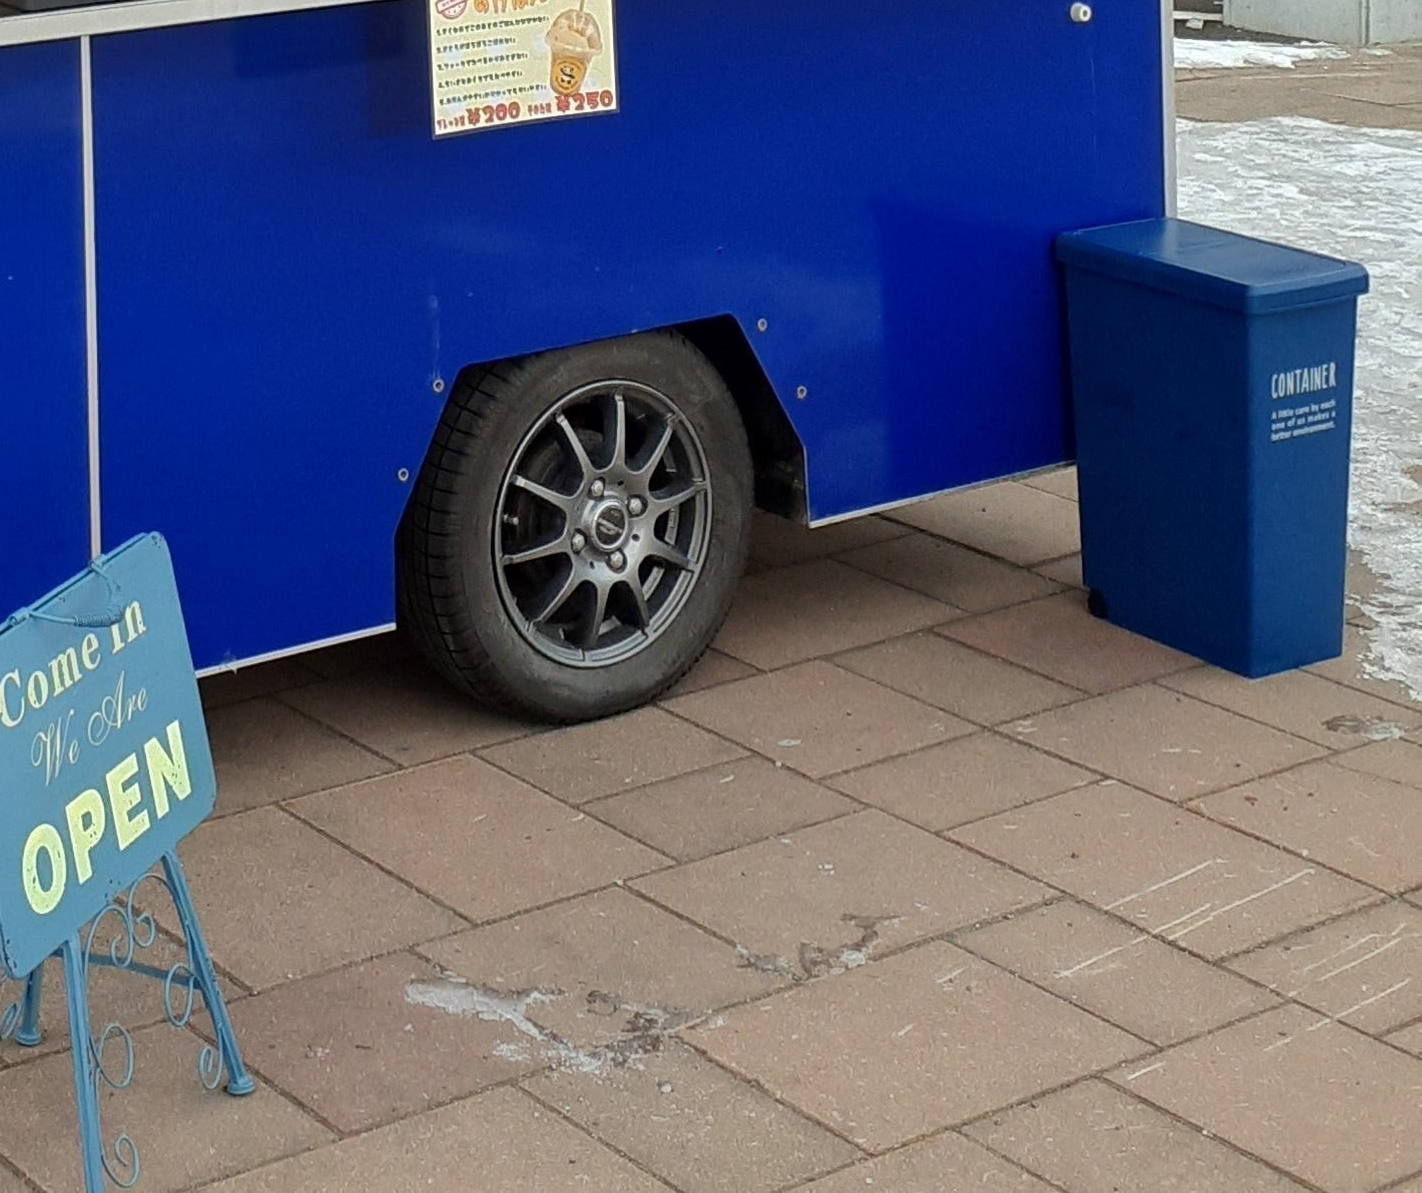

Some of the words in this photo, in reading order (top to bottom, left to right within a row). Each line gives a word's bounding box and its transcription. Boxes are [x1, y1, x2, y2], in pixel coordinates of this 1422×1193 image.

[1271, 362, 1336, 399] CONTAINER
[31, 709, 80, 787] We
[87, 670, 148, 747] Are
[21, 719, 192, 914] OPEN
